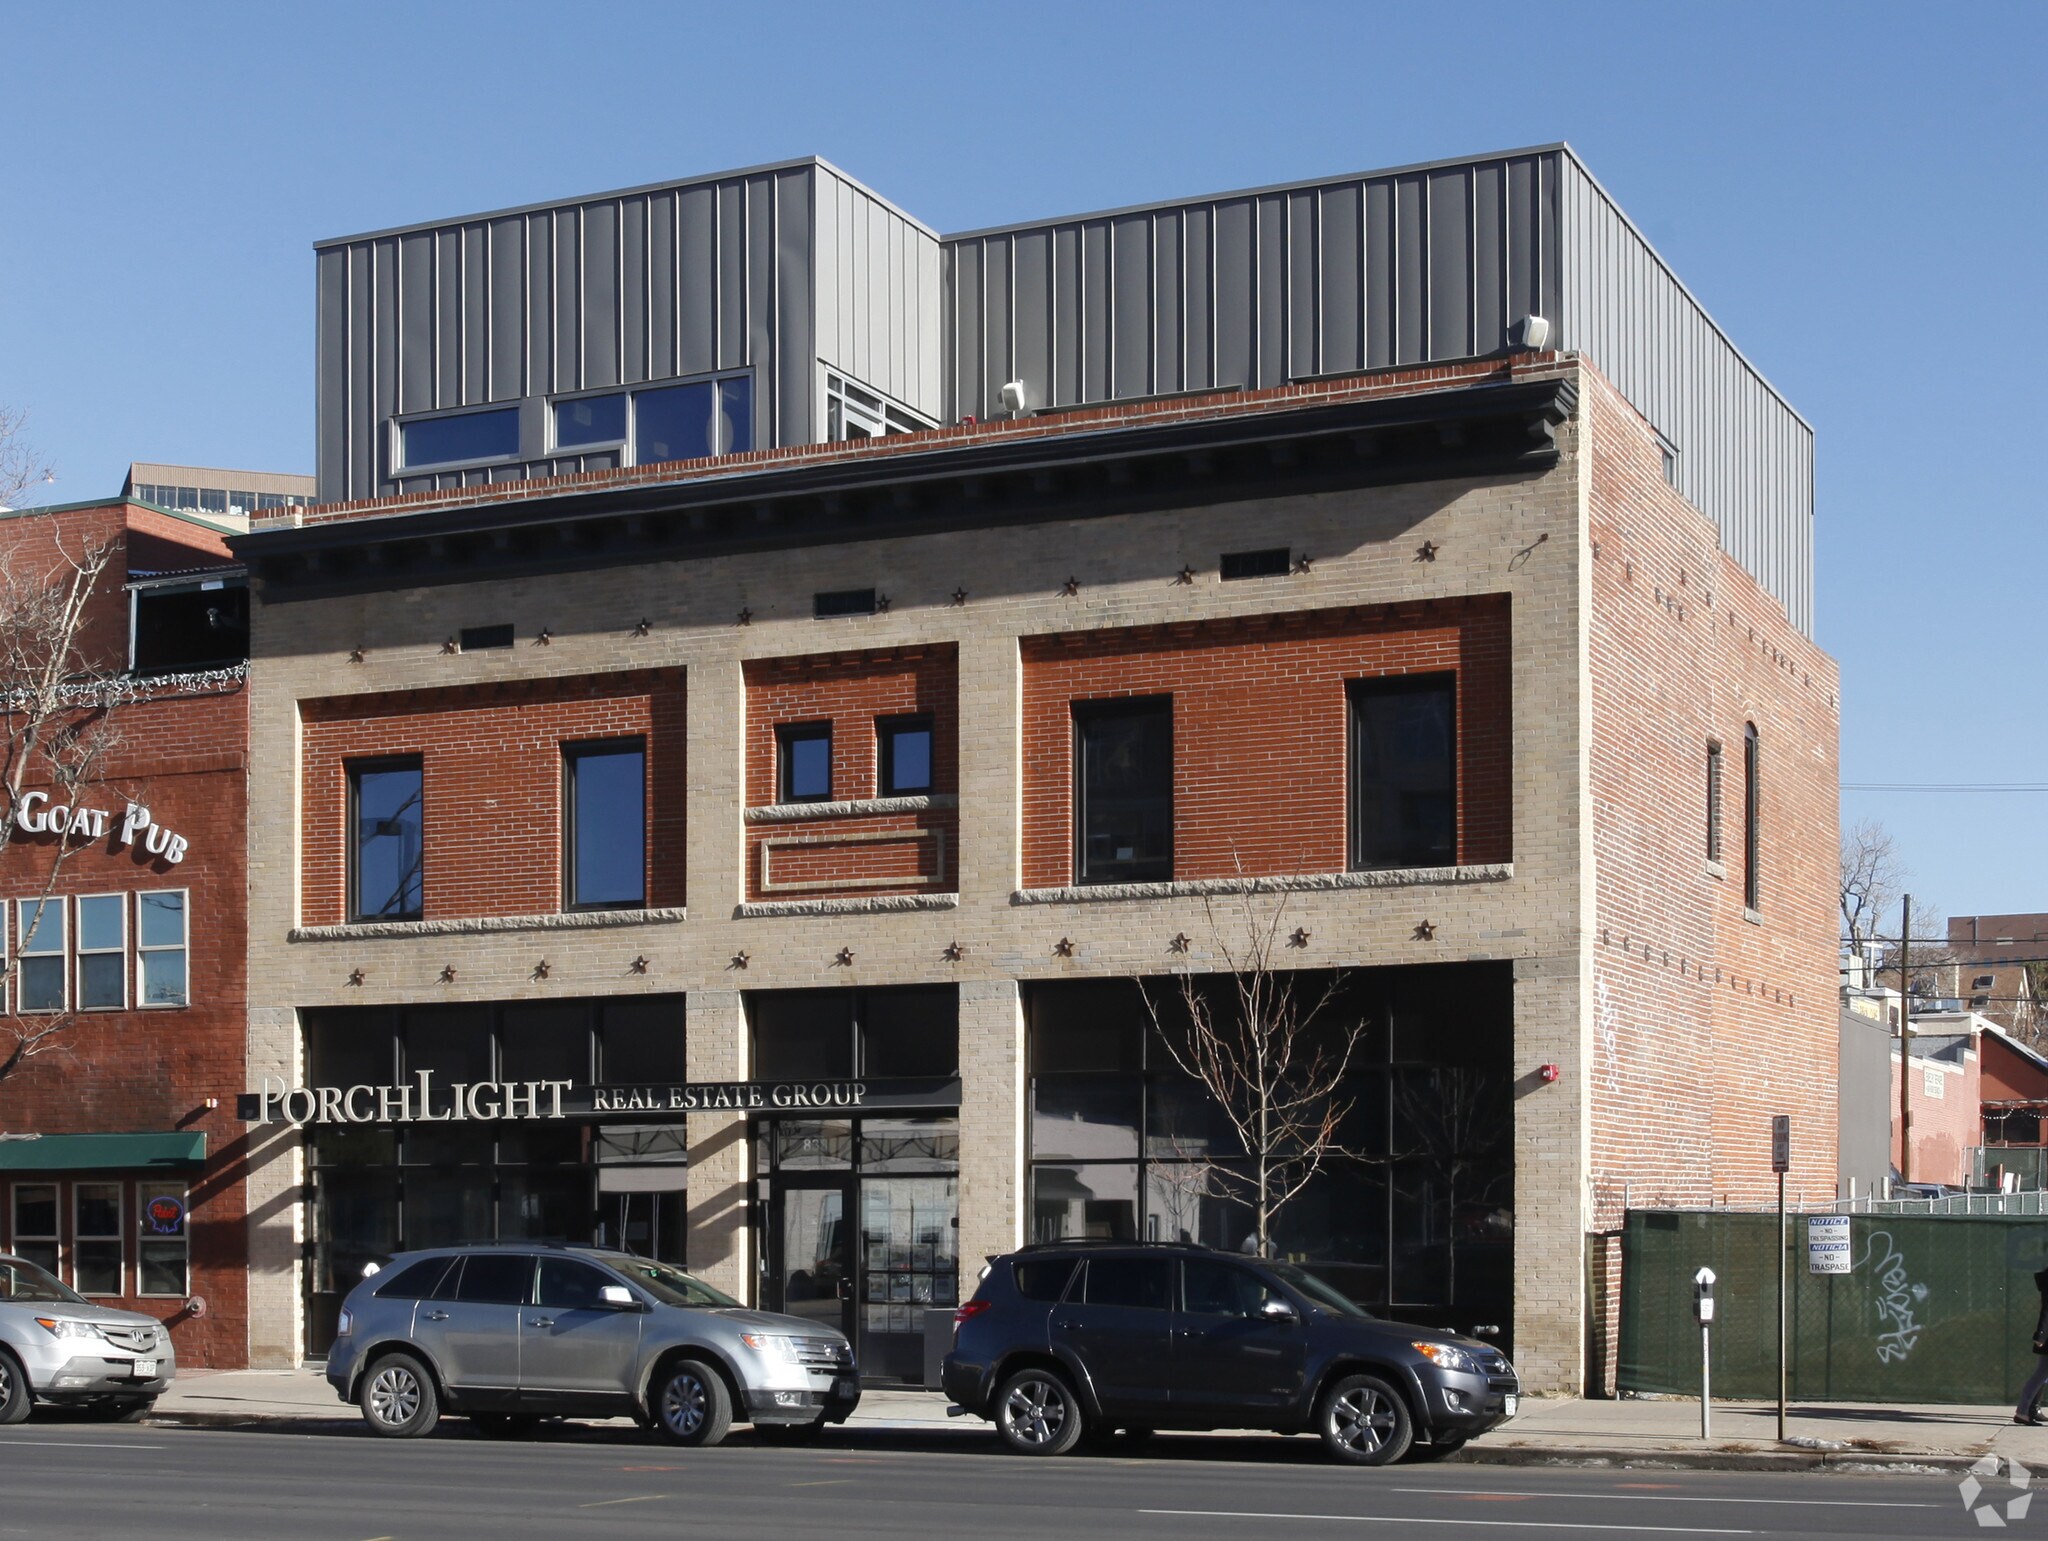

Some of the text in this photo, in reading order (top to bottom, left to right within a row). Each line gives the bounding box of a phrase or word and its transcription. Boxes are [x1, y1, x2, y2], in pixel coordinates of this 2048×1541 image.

[17, 791, 109, 837] GOAT
[120, 803, 189, 864] PUB
[256, 1069, 867, 1125] PORCHLIGHT REAL ESTATE GROUP
